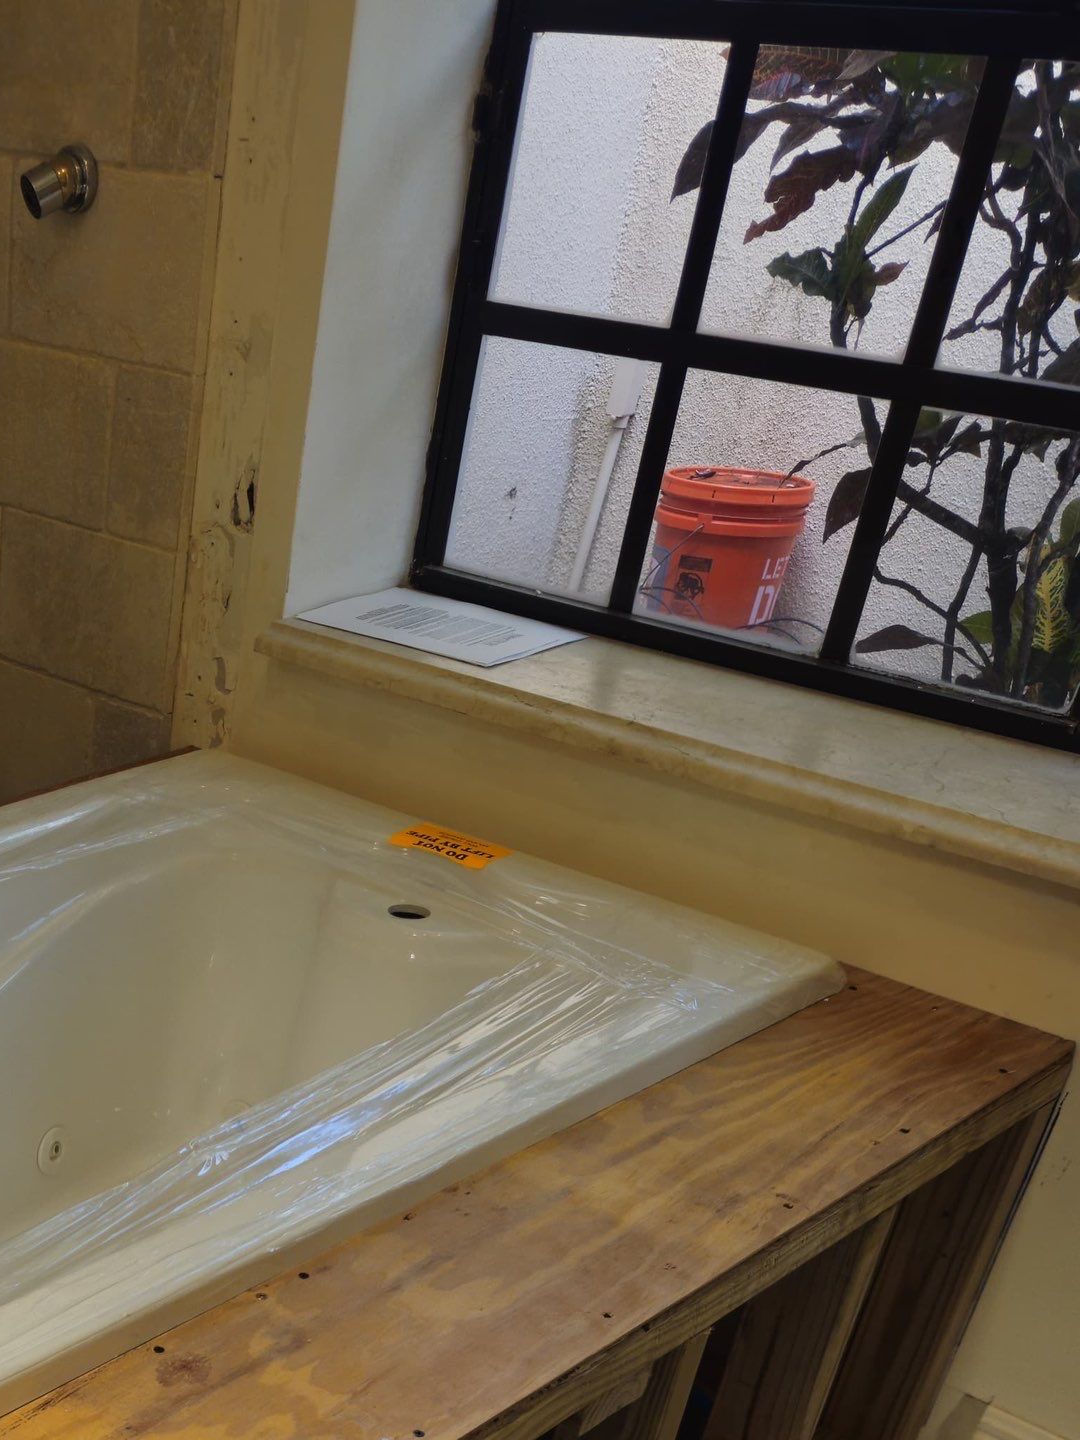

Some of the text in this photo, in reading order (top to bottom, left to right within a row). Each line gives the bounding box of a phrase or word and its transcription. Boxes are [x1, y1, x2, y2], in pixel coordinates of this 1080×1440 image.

[406, 830, 440, 843] PIPE
[412, 840, 469, 861] DO NOT
[440, 840, 461, 849] BY
[461, 847, 496, 859] LIFT
